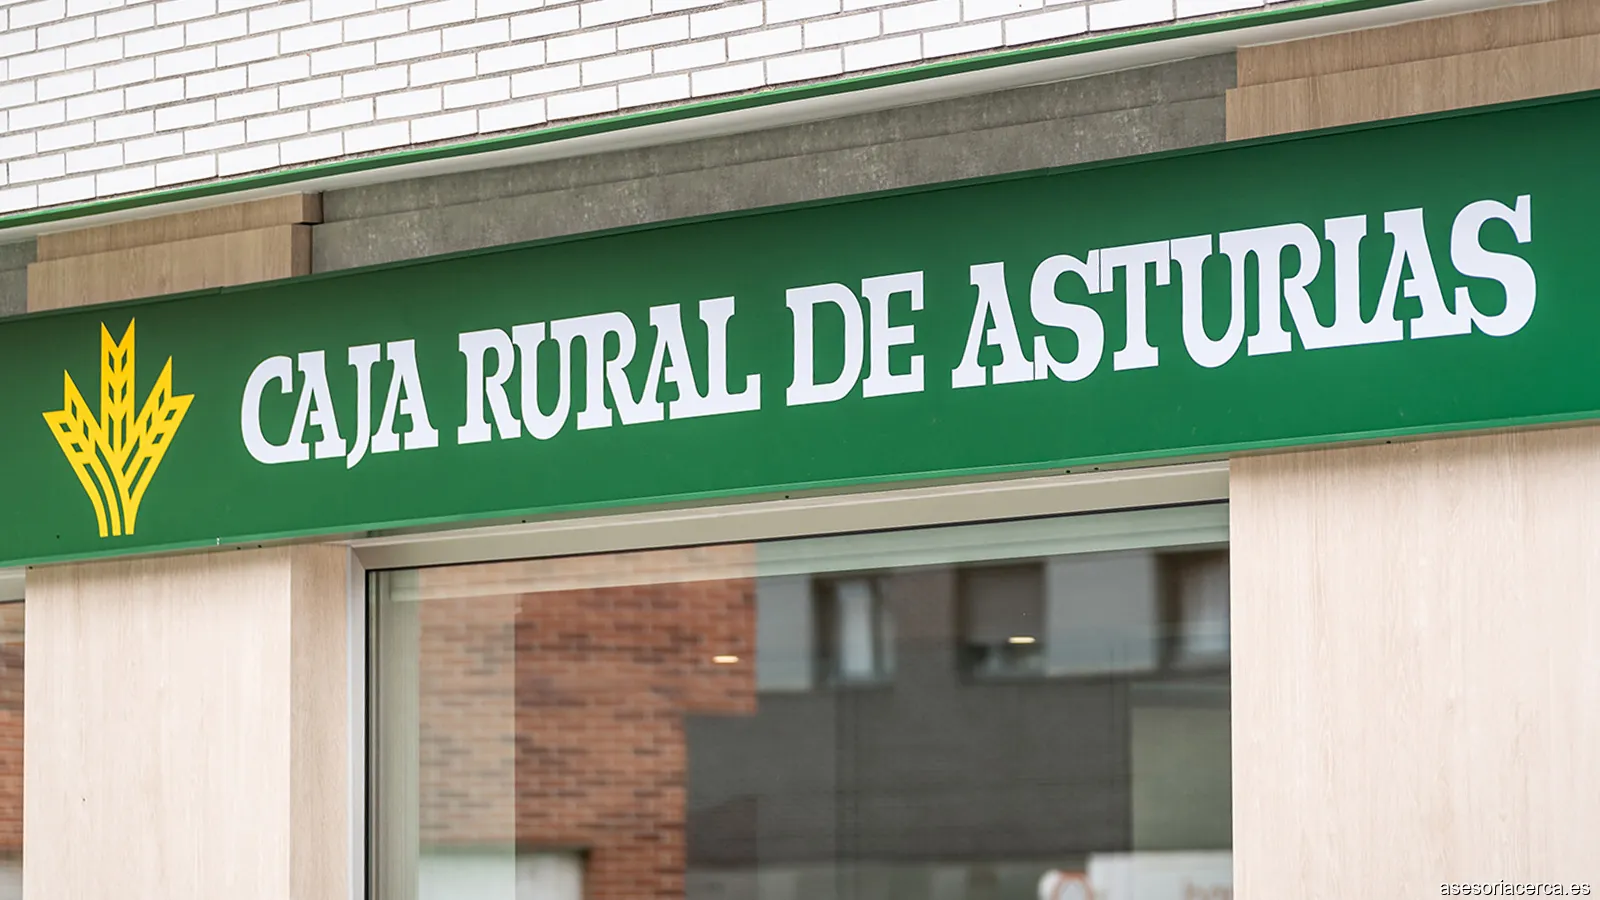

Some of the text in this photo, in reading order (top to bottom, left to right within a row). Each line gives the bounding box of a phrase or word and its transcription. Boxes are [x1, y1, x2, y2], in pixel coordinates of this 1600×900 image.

[241, 194, 1536, 469] CAJA RURAL DE ASTURIAS
